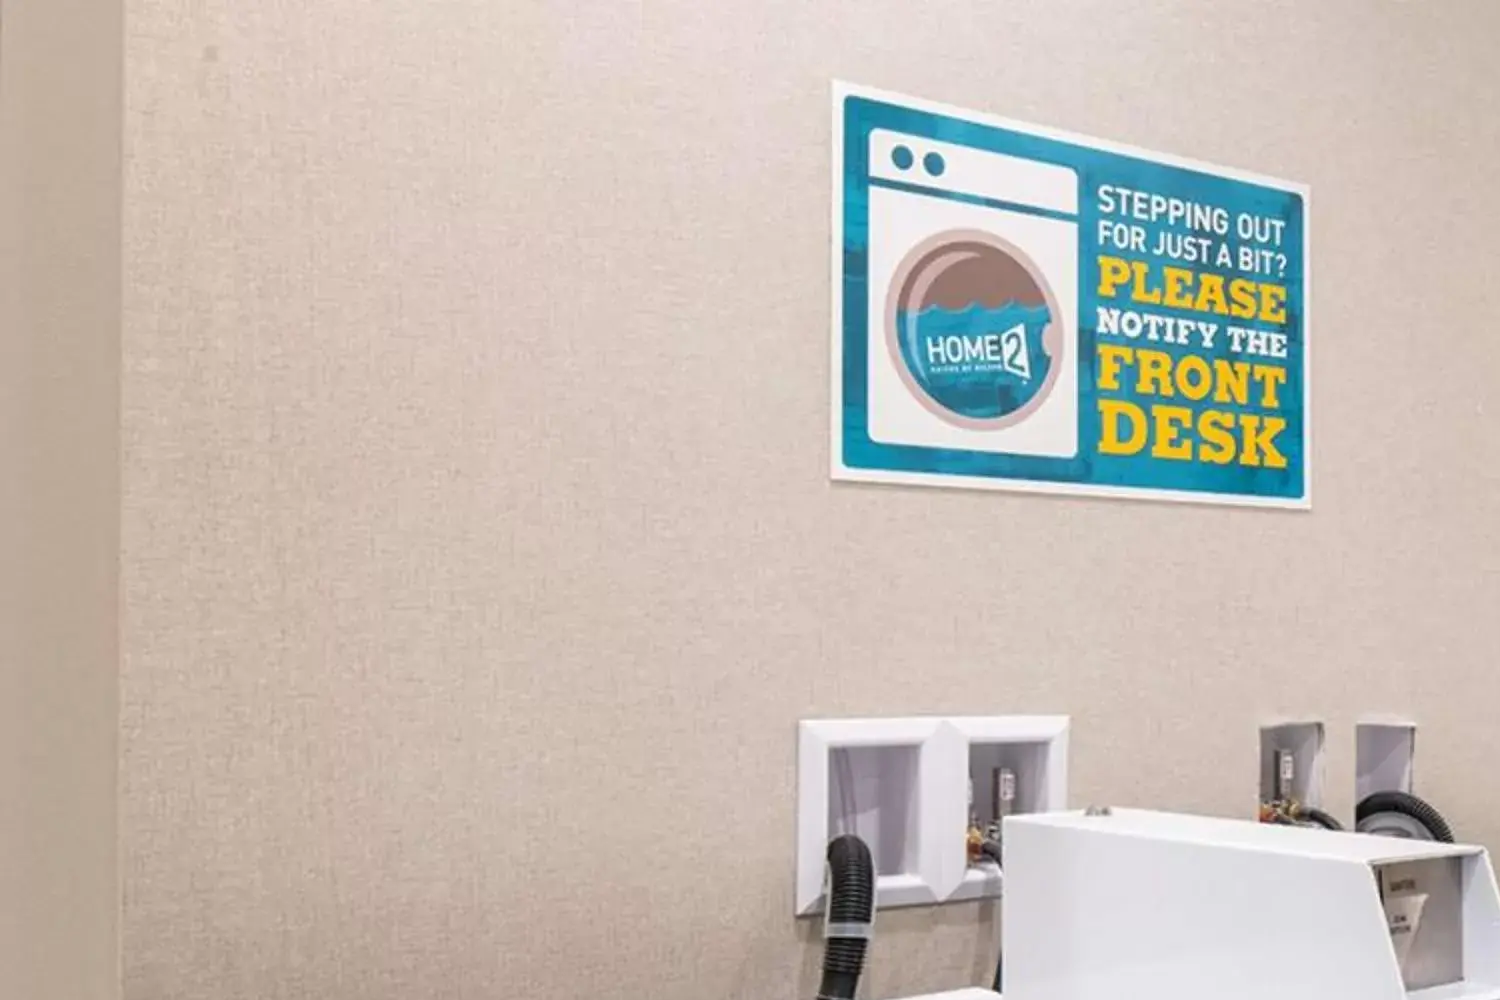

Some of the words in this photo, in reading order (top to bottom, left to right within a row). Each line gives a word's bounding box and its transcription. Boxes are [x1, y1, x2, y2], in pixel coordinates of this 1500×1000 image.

[1097, 184, 1229, 235] STEPPING
[1237, 213, 1286, 246] OUT
[1098, 220, 1147, 253] FOR
[1153, 231, 1212, 264] JUST
[1215, 242, 1233, 269] A
[1239, 245, 1287, 278] BIT?
[1096, 255, 1287, 324] PLEASE
[1096, 305, 1218, 348] NOTIFY
[1227, 326, 1288, 358] THE
[1096, 343, 1286, 408] FRONT
[1097, 398, 1288, 468] DESK
